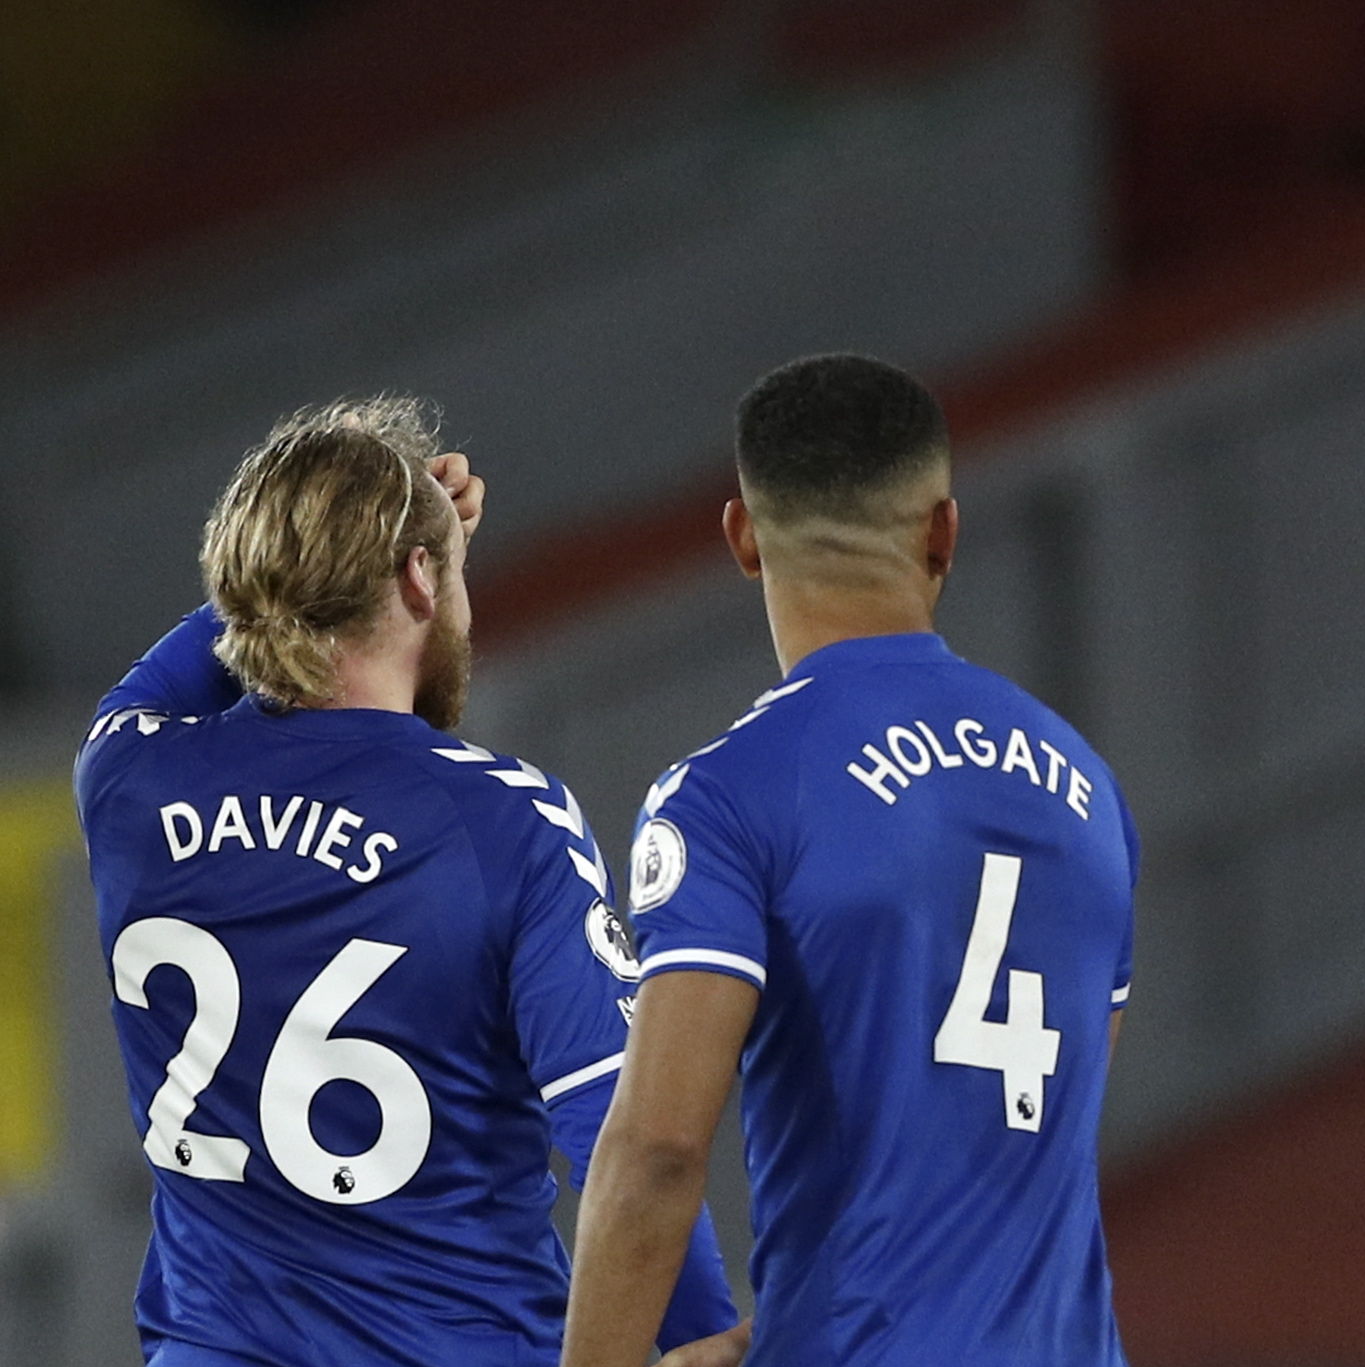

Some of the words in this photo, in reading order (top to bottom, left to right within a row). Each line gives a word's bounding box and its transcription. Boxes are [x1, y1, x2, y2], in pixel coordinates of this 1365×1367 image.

[159, 794, 399, 884] DAVIES
[847, 717, 1093, 821] HOLGATE
[112, 917, 432, 1205] 26
[934, 852, 1061, 1133] 4
